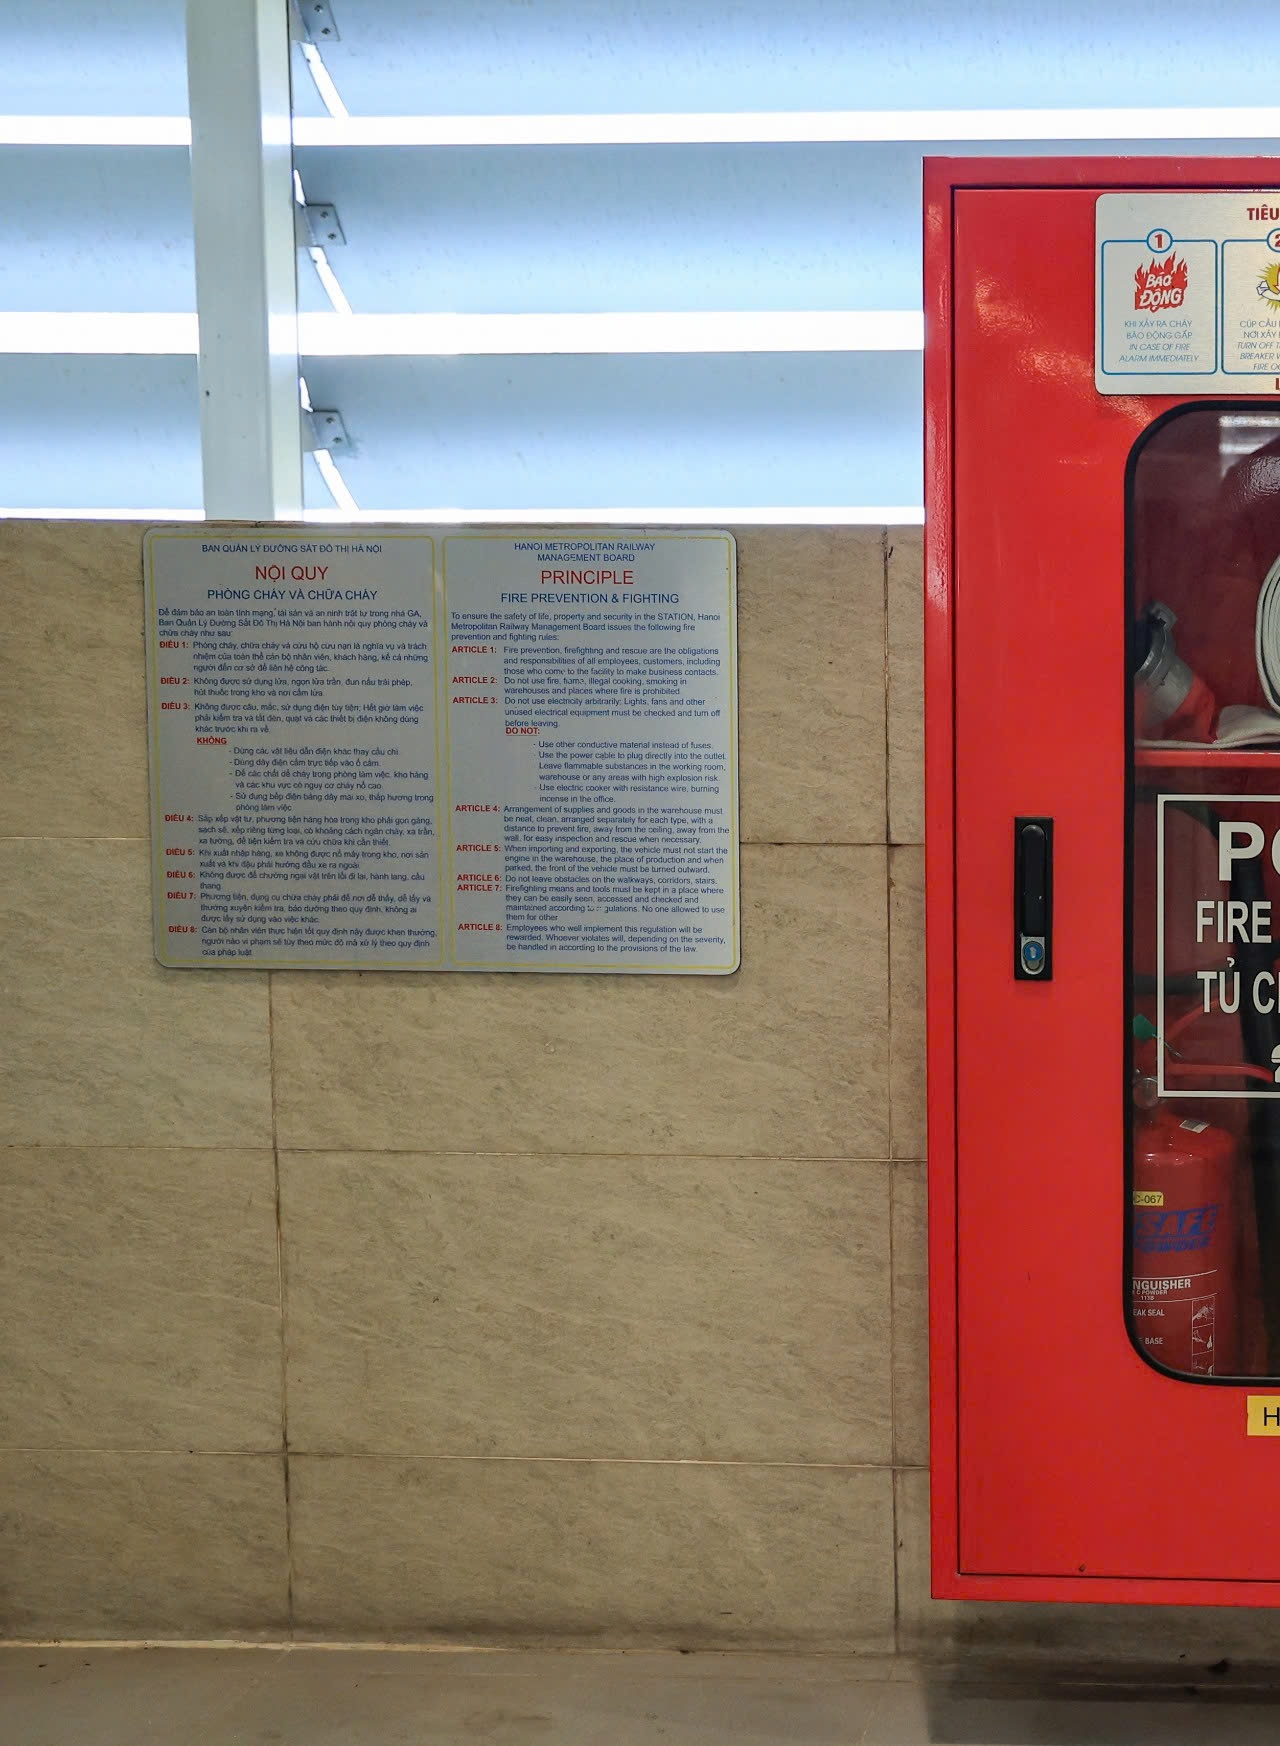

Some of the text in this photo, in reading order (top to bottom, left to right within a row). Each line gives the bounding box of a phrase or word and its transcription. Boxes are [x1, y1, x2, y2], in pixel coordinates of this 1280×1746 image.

[1247, 204, 1279, 221] TIÊU
[1154, 234, 1163, 249] 1
[1145, 271, 1172, 288] BÁO
[1139, 288, 1183, 310] ĐỘNG
[1128, 343, 1190, 351] IN CASE OF FIRE
[514, 542, 655, 551] HANOI METROPOLITAN RAILWAY
[537, 553, 635, 562] MANAGEMENT BOARD
[255, 564, 328, 583] NỘI QUY
[541, 570, 634, 585] PRINCIPLE
[501, 593, 680, 604] FIRE PREVENTION & FIGHTING
[451, 612, 461, 620] To
[490, 612, 502, 620] the
[504, 612, 527, 622] safety
[528, 612, 537, 620] of
[553, 613, 585, 622] property
[586, 613, 601, 621] and
[603, 613, 633, 623] security
[635, 613, 641, 621] in
[643, 613, 656, 621] the
[697, 613, 720, 621] Hanoi
[451, 623, 695, 634] Metropolitan Railway Management Board issues the following fire
[452, 646, 497, 654] ARTICLE 1:
[452, 676, 498, 684] ARTICLE 2:
[505, 727, 540, 735] DO NOT:
[456, 844, 501, 852] ARTICLE 5:
[457, 874, 502, 882] ARTICLE 6:
[457, 884, 502, 892] ARTICLE 7:
[458, 923, 503, 931] ARTICLE 8:
[1196, 900, 1272, 943] FIRE
[1196, 957, 1240, 1014] TỦ
[1133, 1279, 1191, 1291] NGUISHER
[1145, 1337, 1164, 1345] BASE
